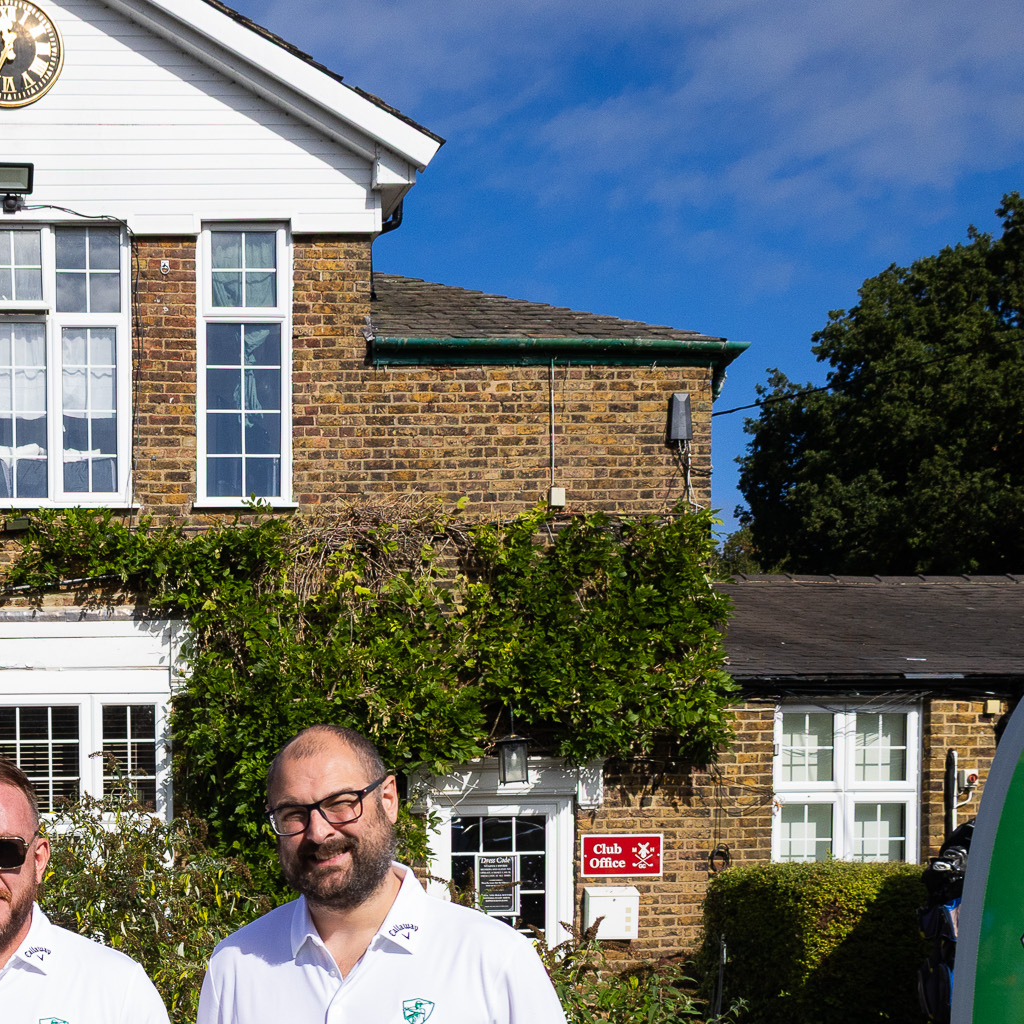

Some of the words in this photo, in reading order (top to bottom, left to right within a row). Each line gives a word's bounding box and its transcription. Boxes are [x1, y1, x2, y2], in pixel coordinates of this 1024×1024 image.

[593, 843, 622, 854] Club
[589, 857, 626, 869] Office
[388, 923, 419, 937] Callaway
